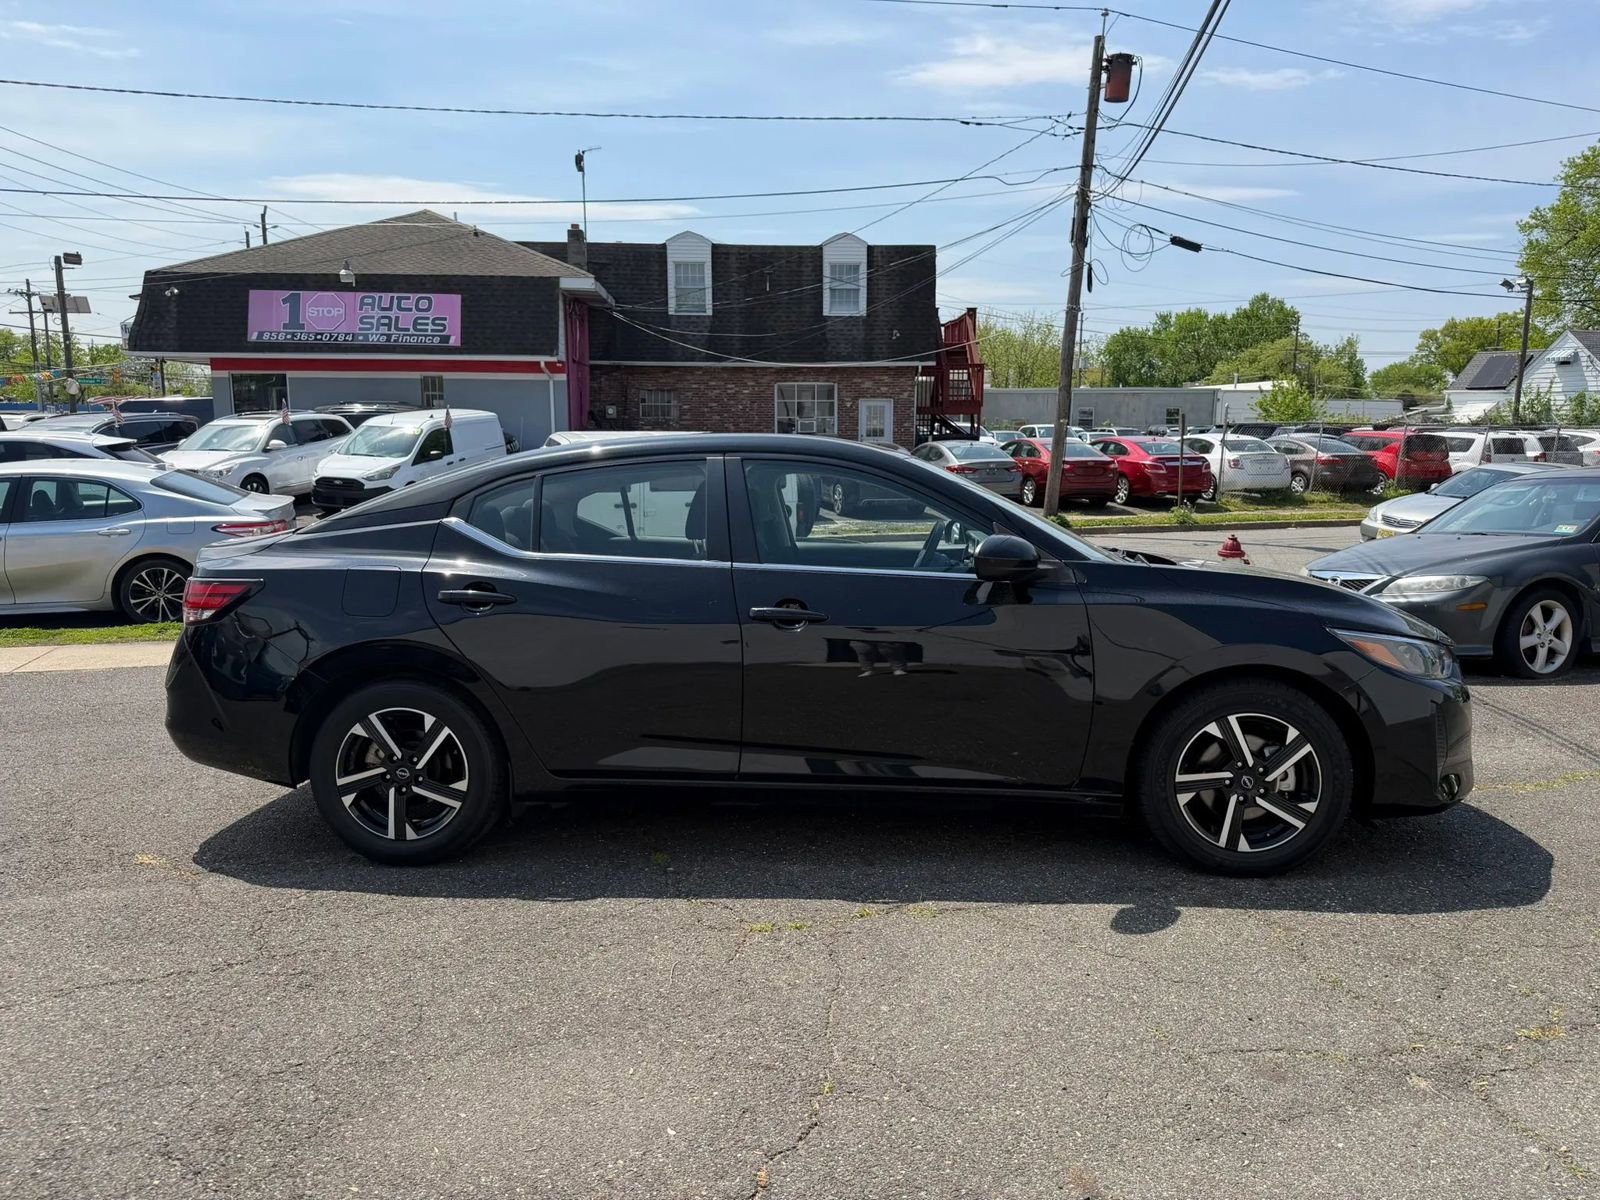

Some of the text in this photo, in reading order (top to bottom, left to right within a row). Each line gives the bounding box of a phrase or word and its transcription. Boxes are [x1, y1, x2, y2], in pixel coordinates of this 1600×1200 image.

[281, 291, 343, 331] 1 STOP
[358, 295, 433, 313] AUTO
[358, 315, 447, 333] SALES
[368, 334, 387, 343] We
[391, 334, 441, 343] Finance
